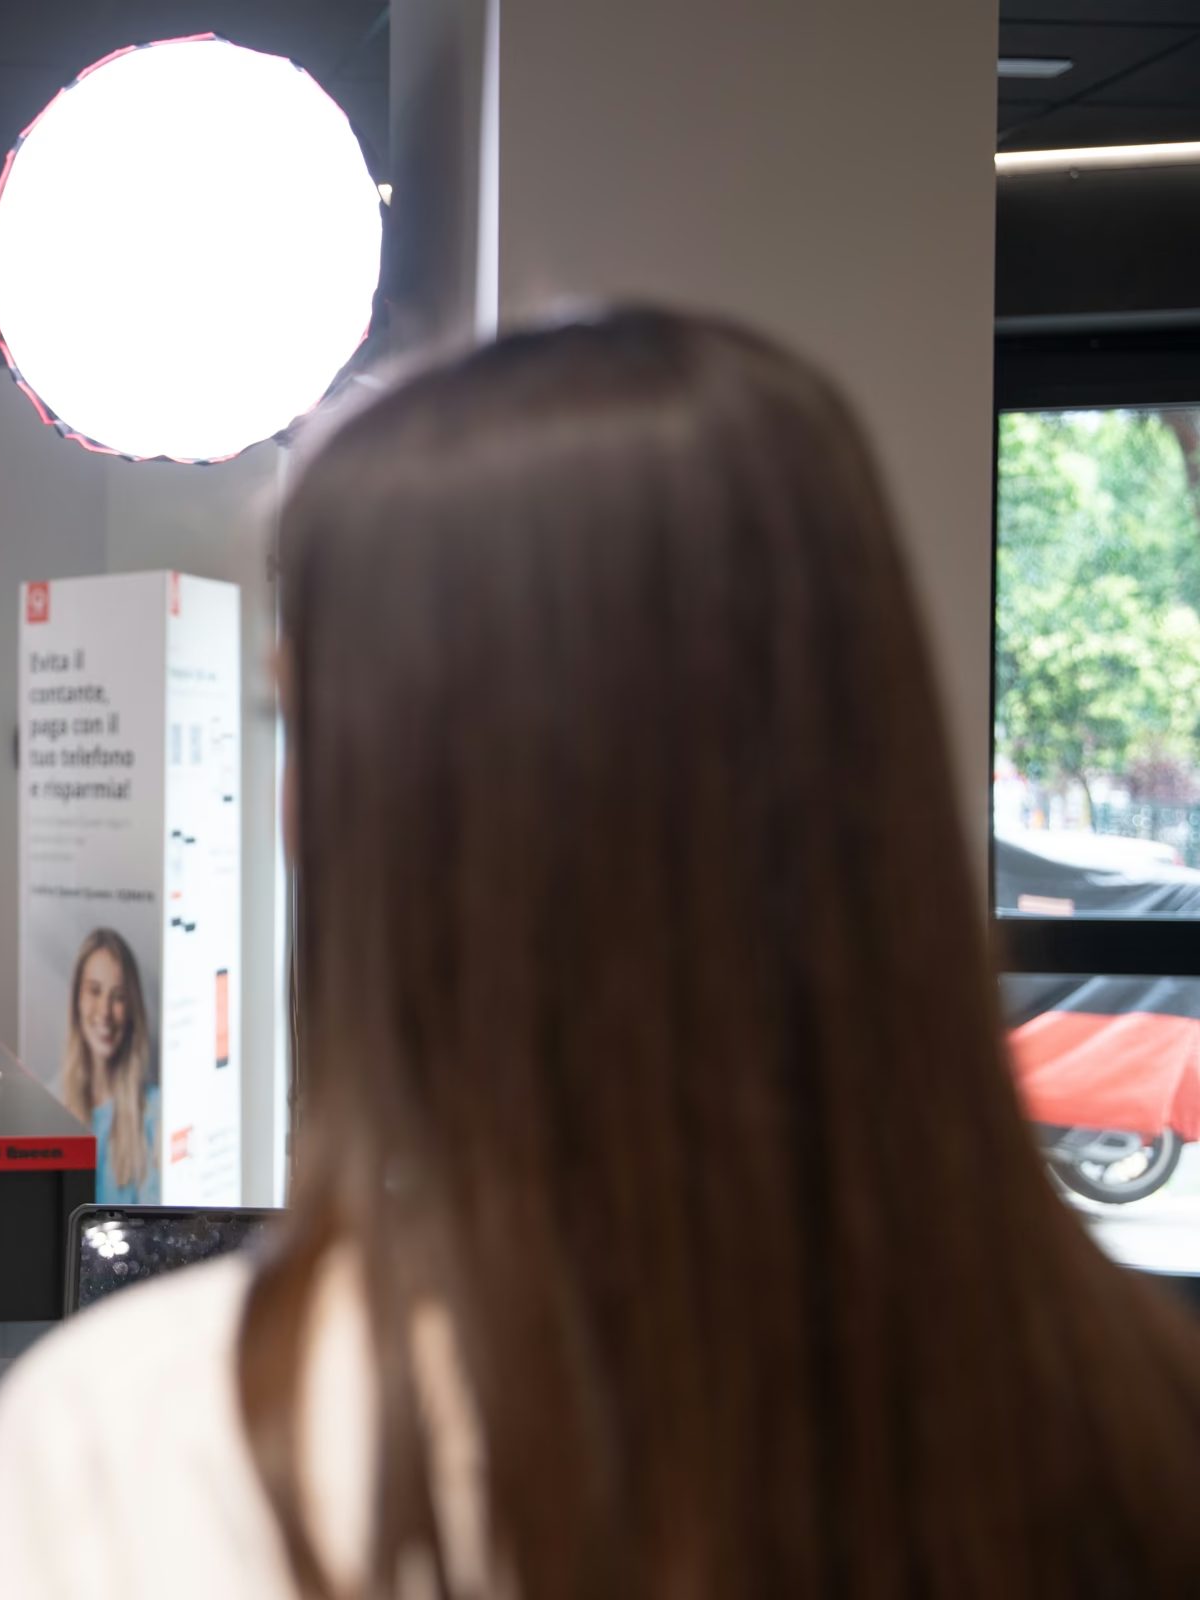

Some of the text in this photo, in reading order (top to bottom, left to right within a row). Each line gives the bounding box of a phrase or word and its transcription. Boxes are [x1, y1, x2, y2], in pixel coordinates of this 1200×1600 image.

[30, 651, 69, 673] Evita
[30, 711, 119, 741] paga con il
[30, 744, 135, 768] tuo telefono
[7, 1146, 63, 1160] Queen
